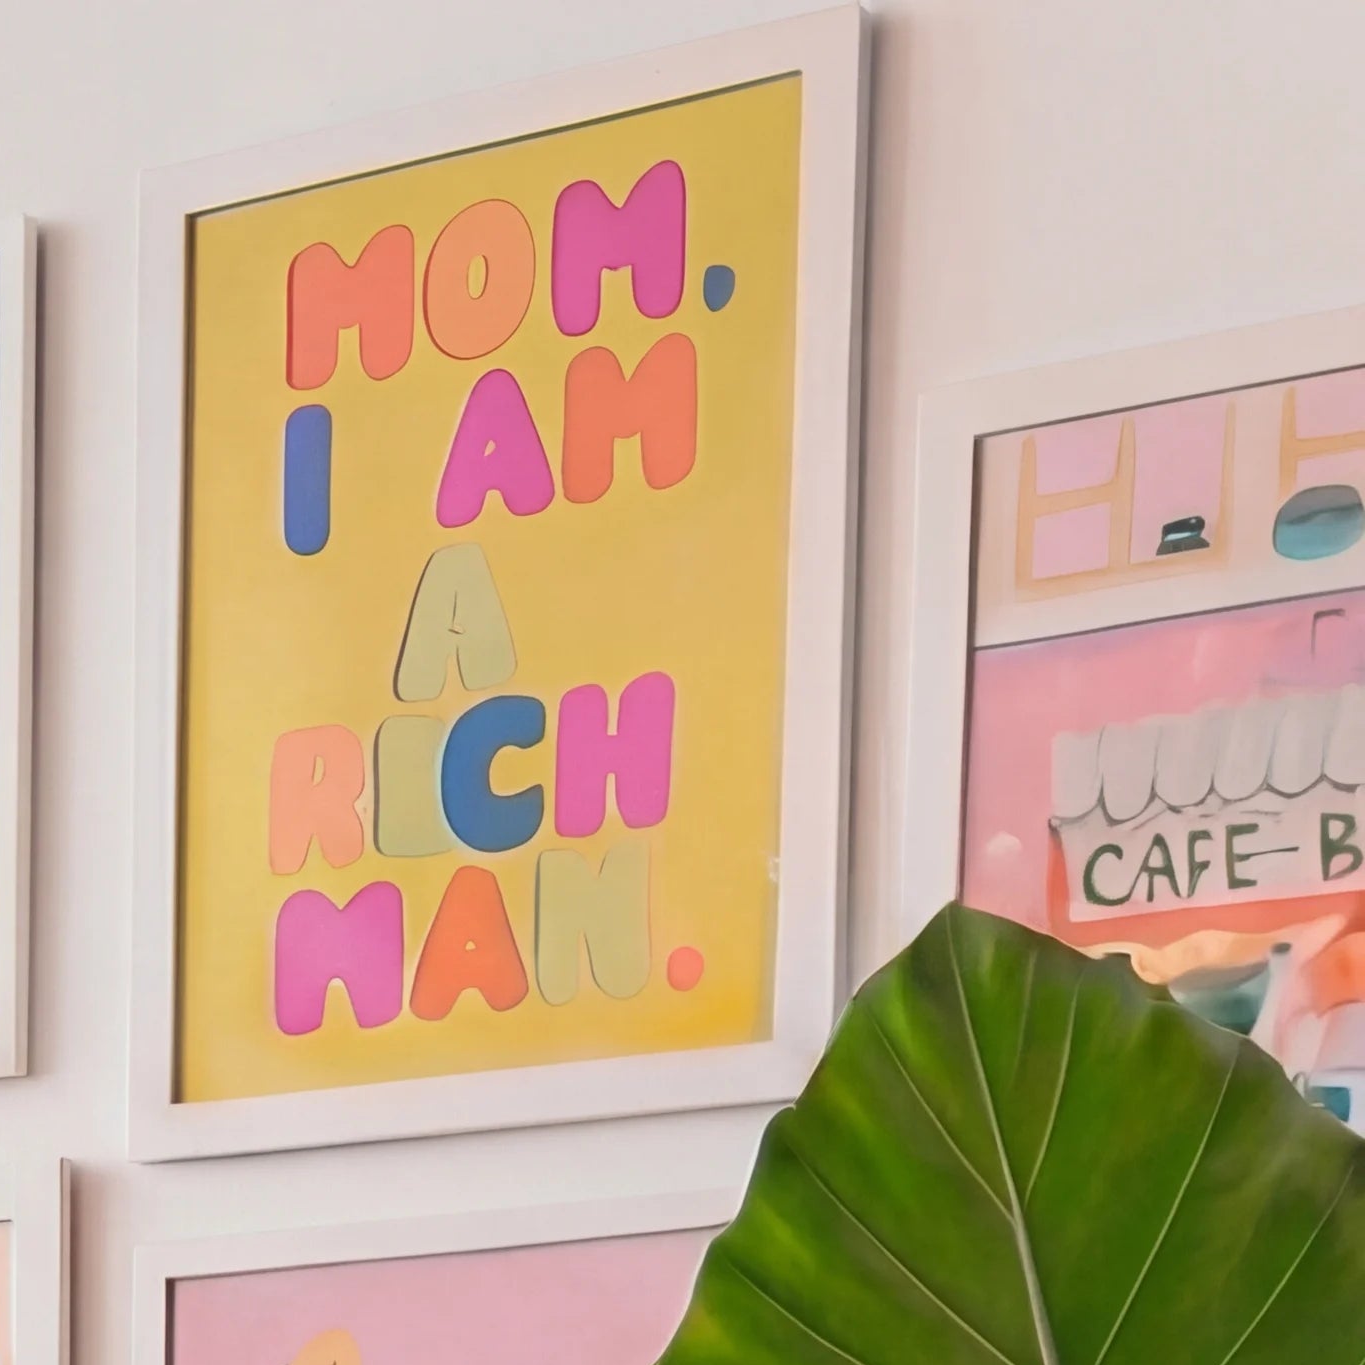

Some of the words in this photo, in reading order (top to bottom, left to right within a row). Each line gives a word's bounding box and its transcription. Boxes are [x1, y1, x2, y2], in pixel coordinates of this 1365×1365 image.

[283, 403, 332, 556] I
[435, 332, 698, 529] AM
[392, 541, 518, 703] A
[269, 671, 676, 875] RICH
[274, 845, 704, 1035] MAN.
